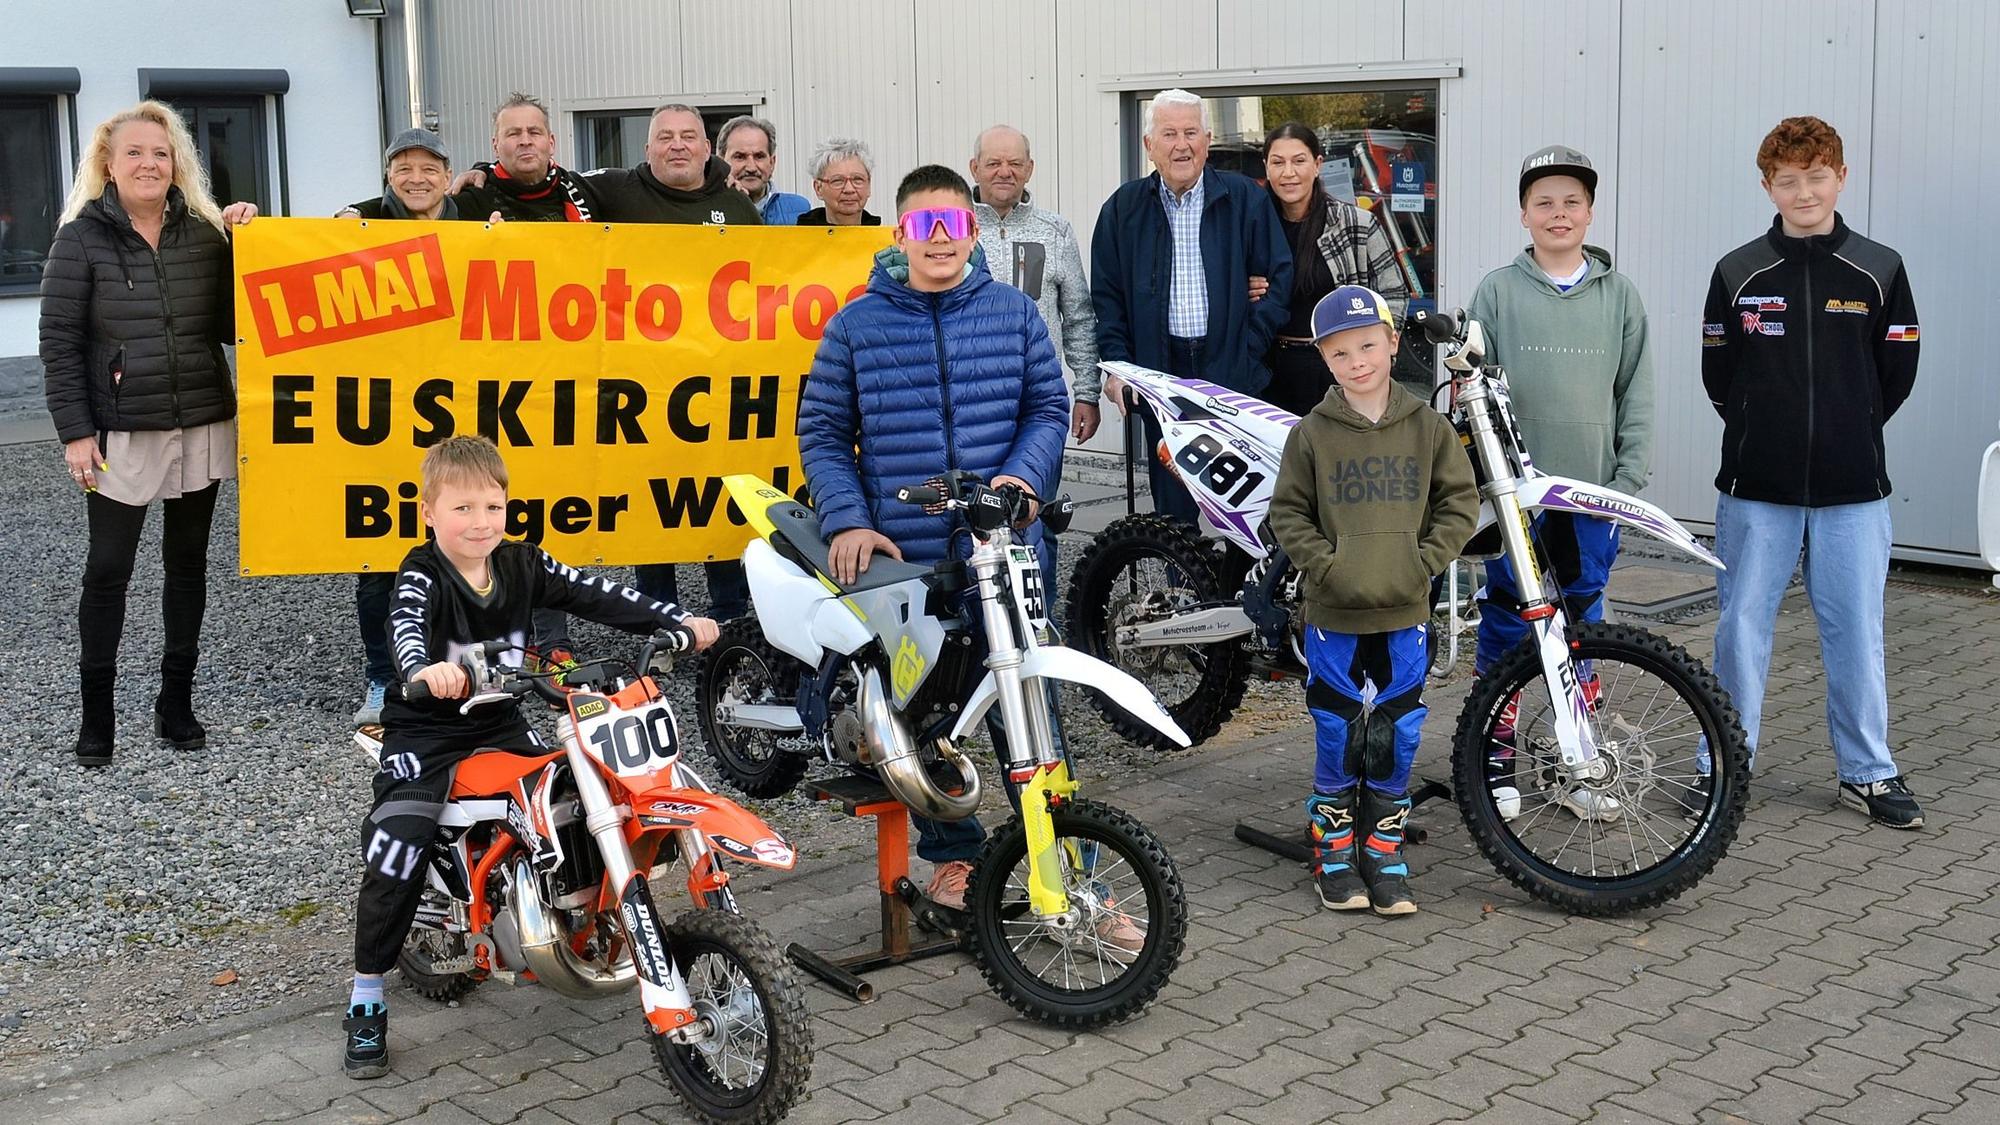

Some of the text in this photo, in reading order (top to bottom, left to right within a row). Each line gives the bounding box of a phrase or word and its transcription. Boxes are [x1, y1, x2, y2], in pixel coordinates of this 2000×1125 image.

[259, 252, 436, 338] 1.MAI
[460, 260, 866, 341] Moto Cro
[273, 375, 808, 448] EUSKIRCH
[1175, 434, 1265, 508] 881
[1328, 456, 1420, 483] JACK&
[1328, 480, 1420, 505] JONES
[1572, 492, 1644, 517] NINETYTWO
[579, 700, 603, 716] ADAC
[590, 707, 678, 773] 100
[366, 828, 424, 880] FLY
[623, 905, 636, 931] SHOEI
[636, 903, 675, 992] DUNLOP
